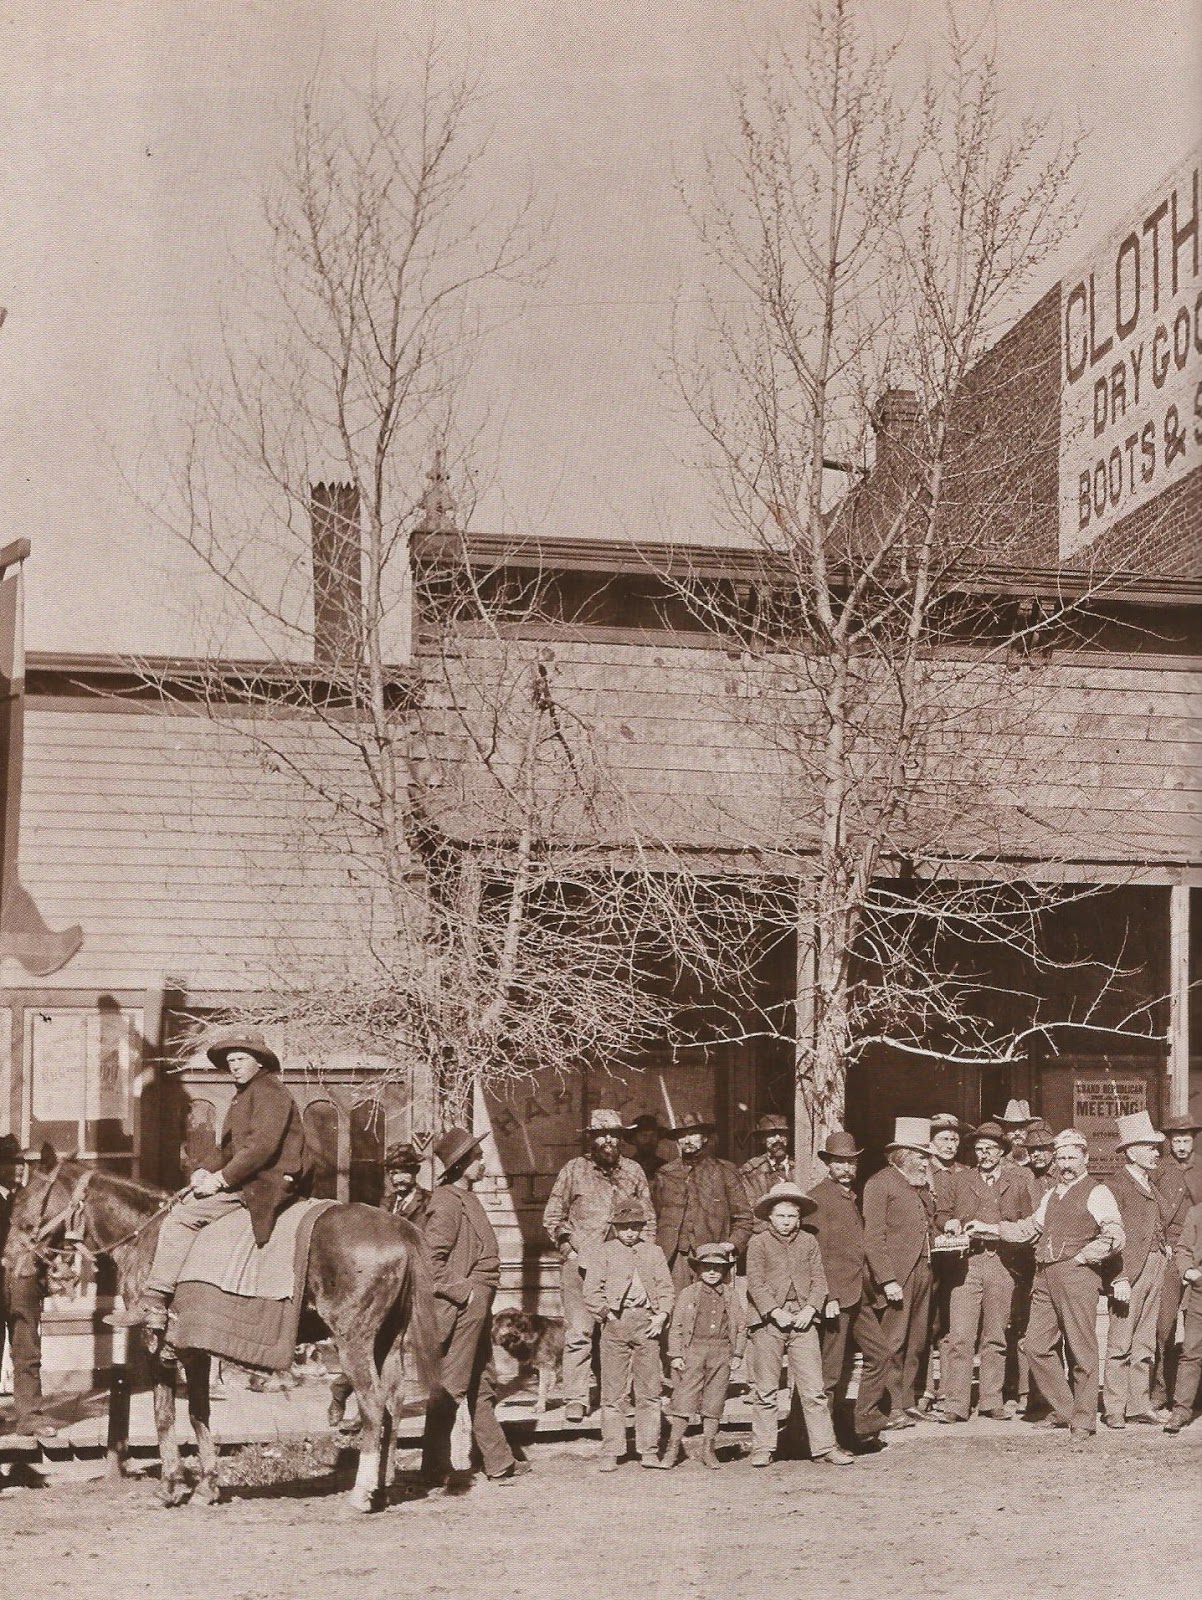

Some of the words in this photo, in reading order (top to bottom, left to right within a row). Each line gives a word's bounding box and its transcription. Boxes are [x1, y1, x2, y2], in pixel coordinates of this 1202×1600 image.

[1065, 168, 1199, 386] CLOTH
[1093, 341, 1145, 439] DRY
[1078, 419, 1156, 532] BOOTS
[1163, 403, 1187, 468] &
